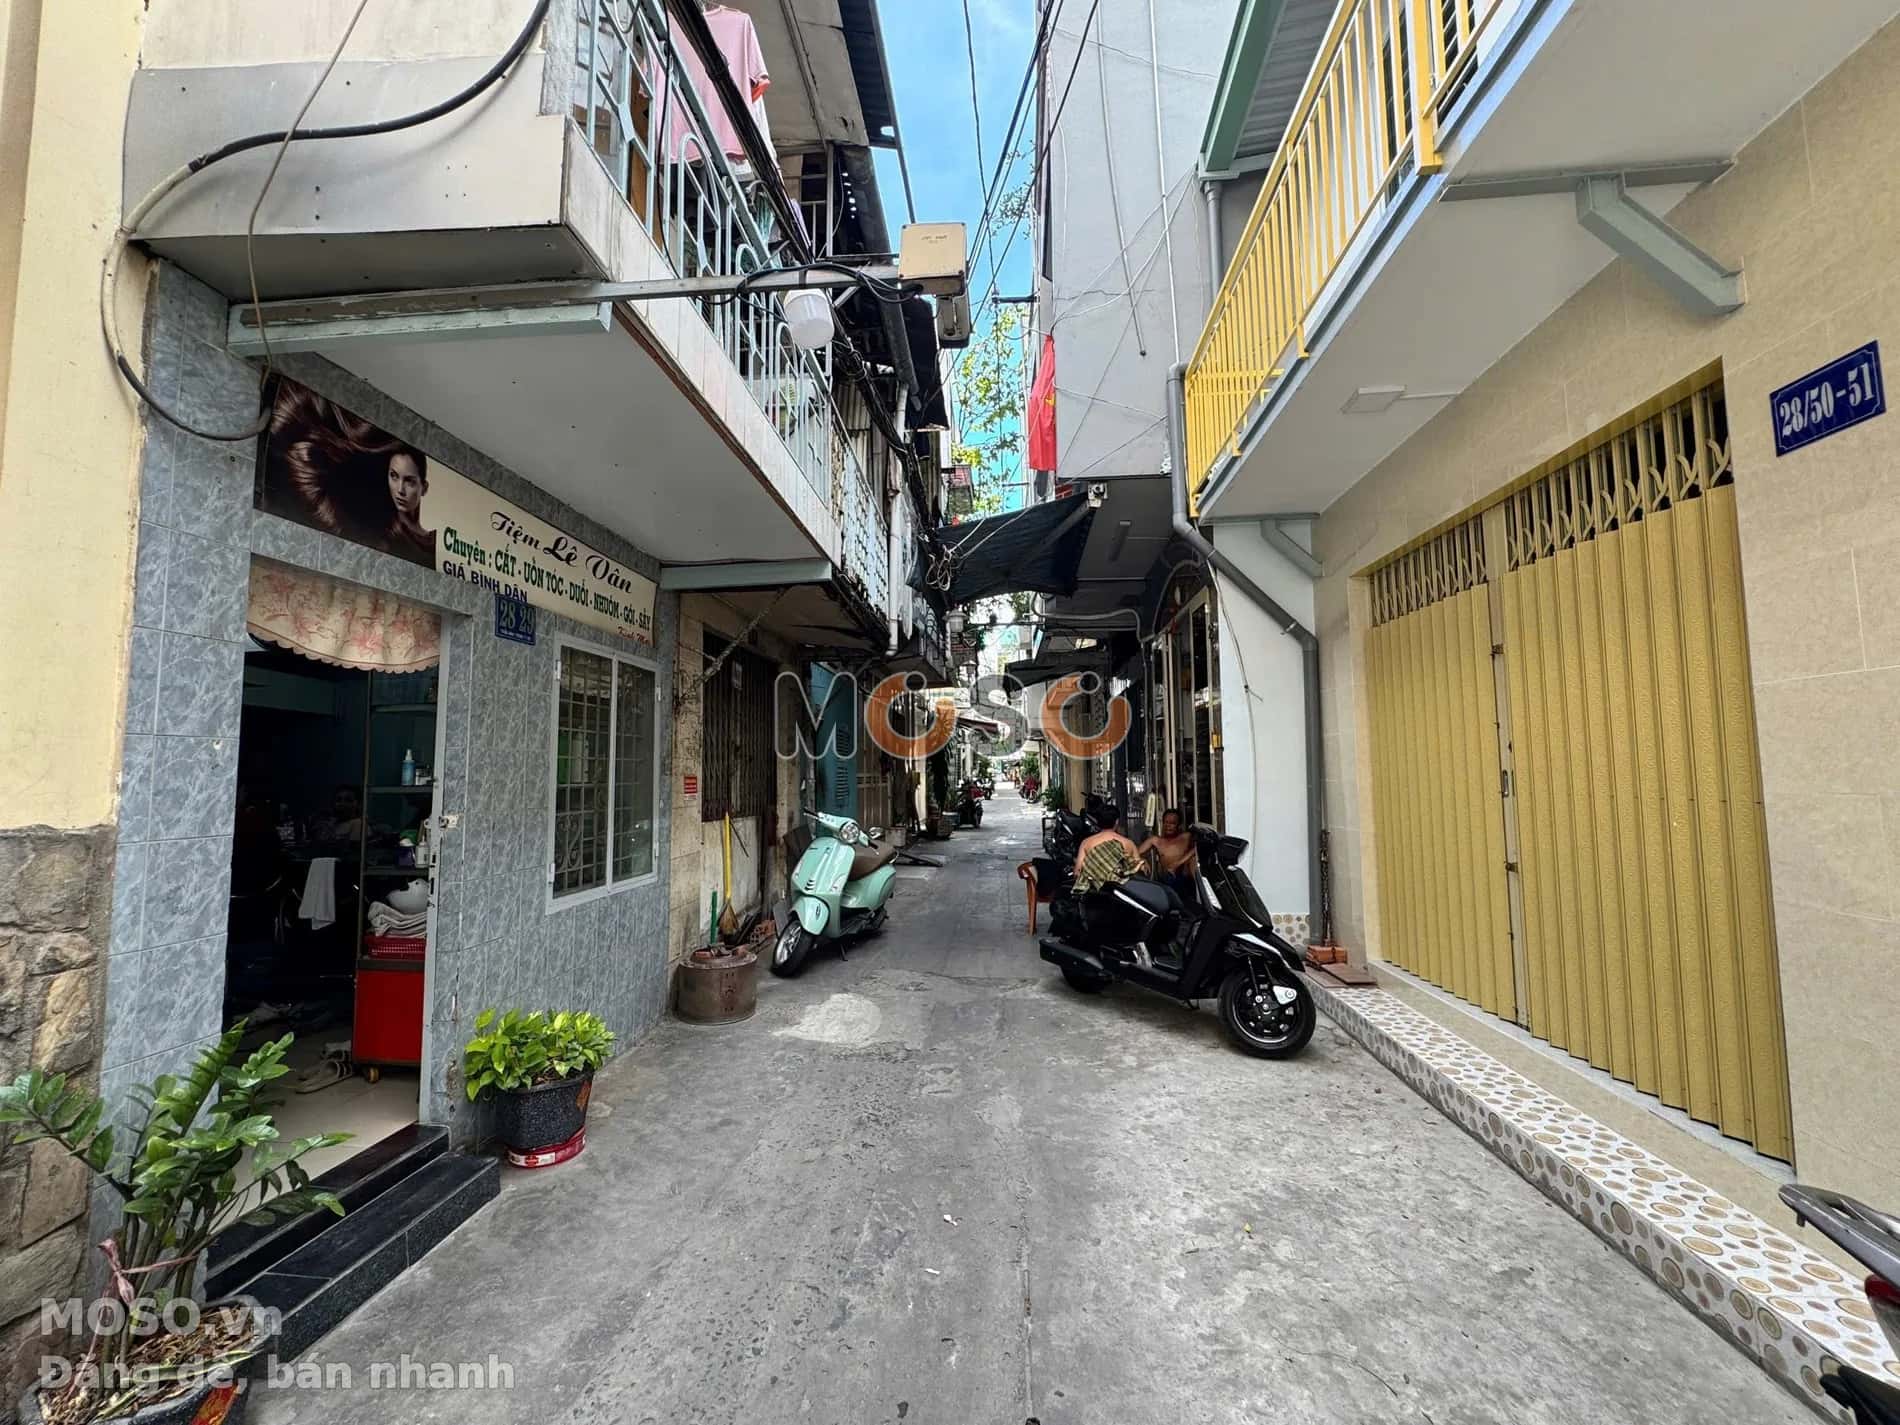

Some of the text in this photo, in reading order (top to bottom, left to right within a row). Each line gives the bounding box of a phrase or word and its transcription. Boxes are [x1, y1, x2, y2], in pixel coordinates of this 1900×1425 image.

[443, 526, 486, 566] Chuyên
[490, 511, 632, 594] Tiệm Lê Vân
[442, 559, 529, 603] GIÁ BÌNH DÂN
[499, 600, 516, 629] 28
